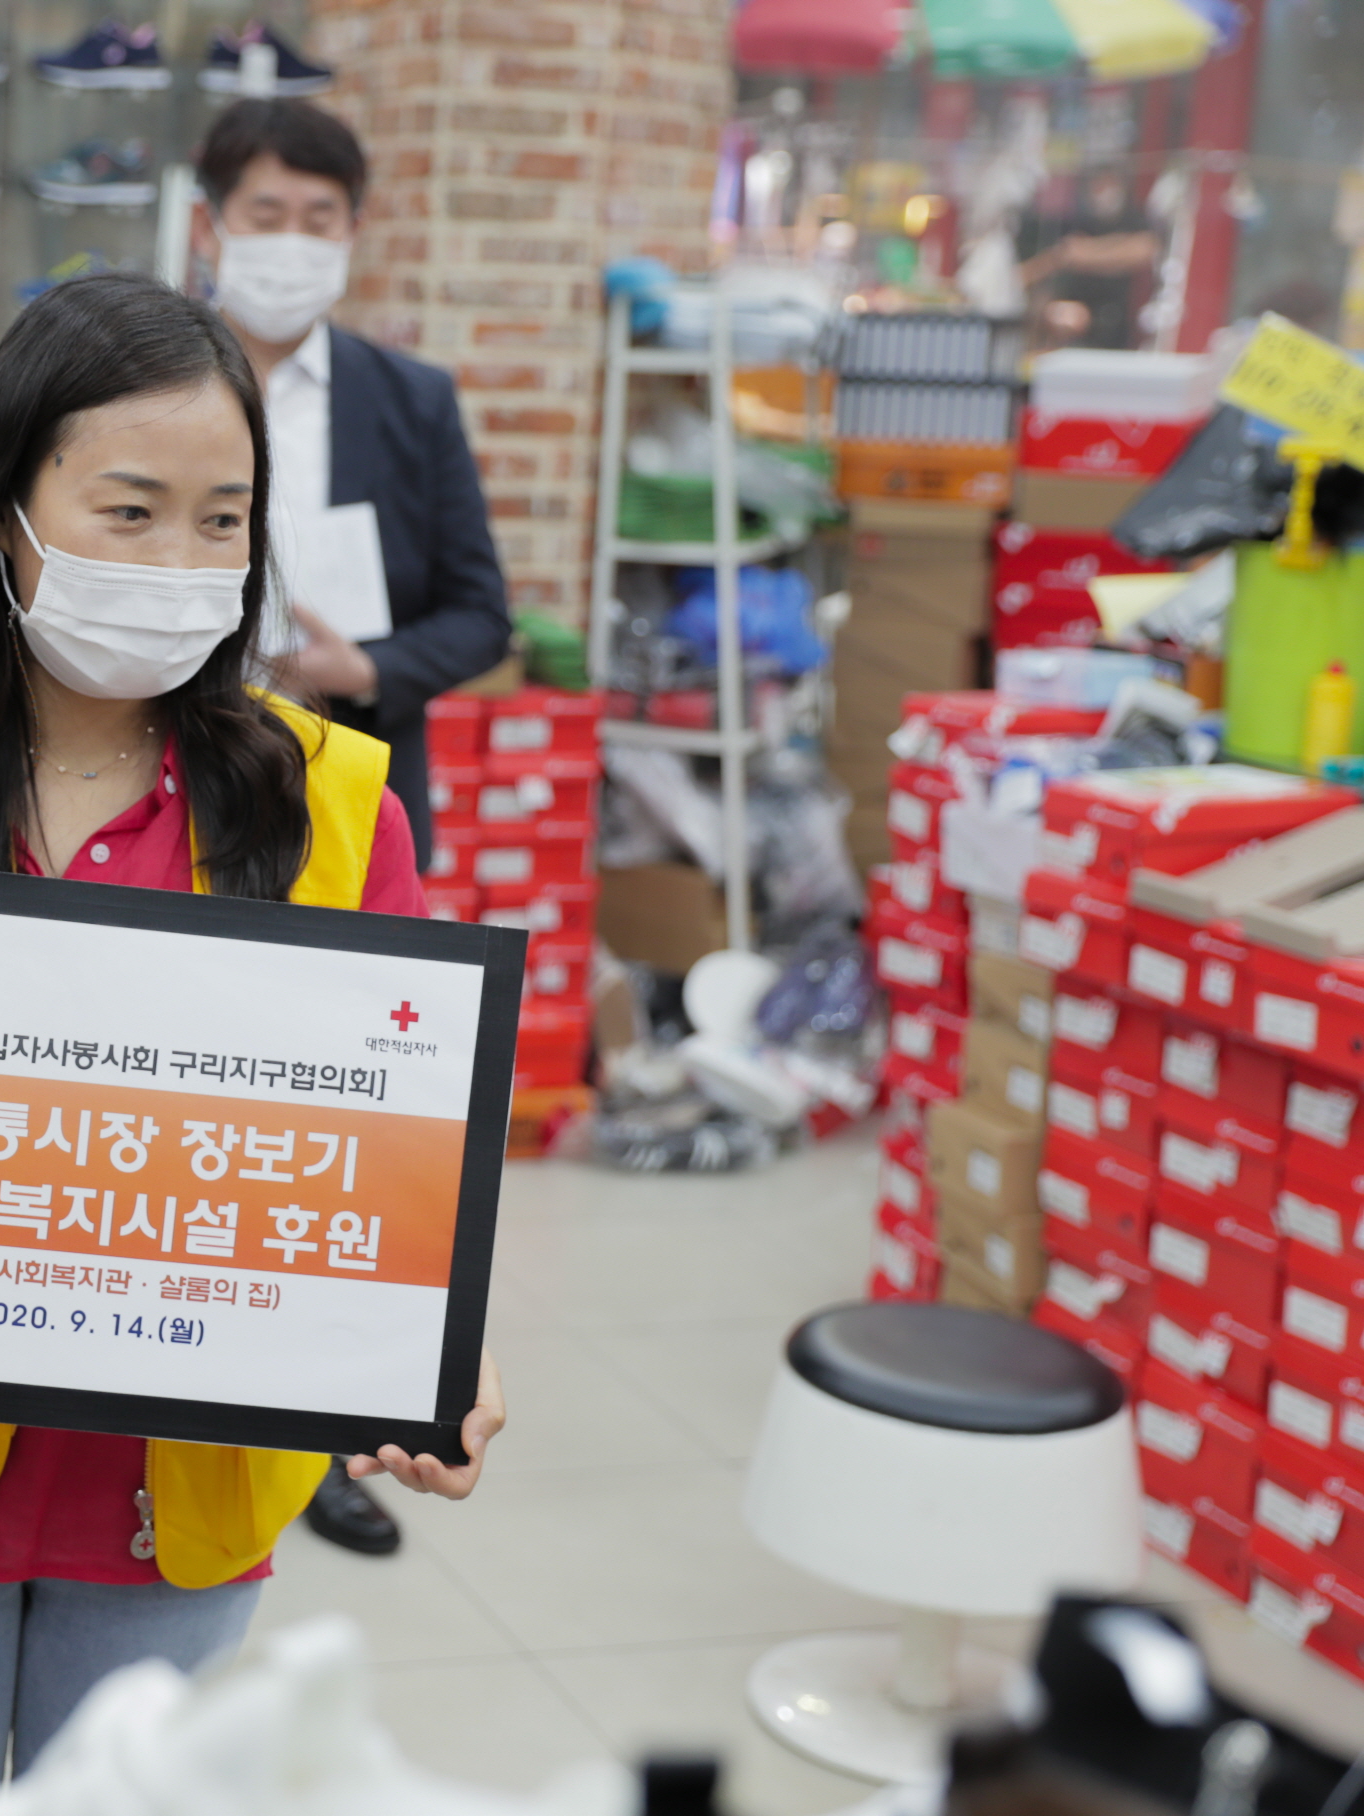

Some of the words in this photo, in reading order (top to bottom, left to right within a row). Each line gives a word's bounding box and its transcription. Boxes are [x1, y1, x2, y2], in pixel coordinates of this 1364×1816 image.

[365, 1037, 438, 1057] 대한적십자사
[169, 1050, 387, 1101] 구리지구협의회]
[180, 1119, 359, 1193] 장보기
[262, 1203, 382, 1272] 후원
[159, 1274, 238, 1305] 샬롬의
[248, 1281, 281, 1311] 집)
[70, 1309, 94, 1334] 9.
[112, 1313, 205, 1347] 14.(월)
